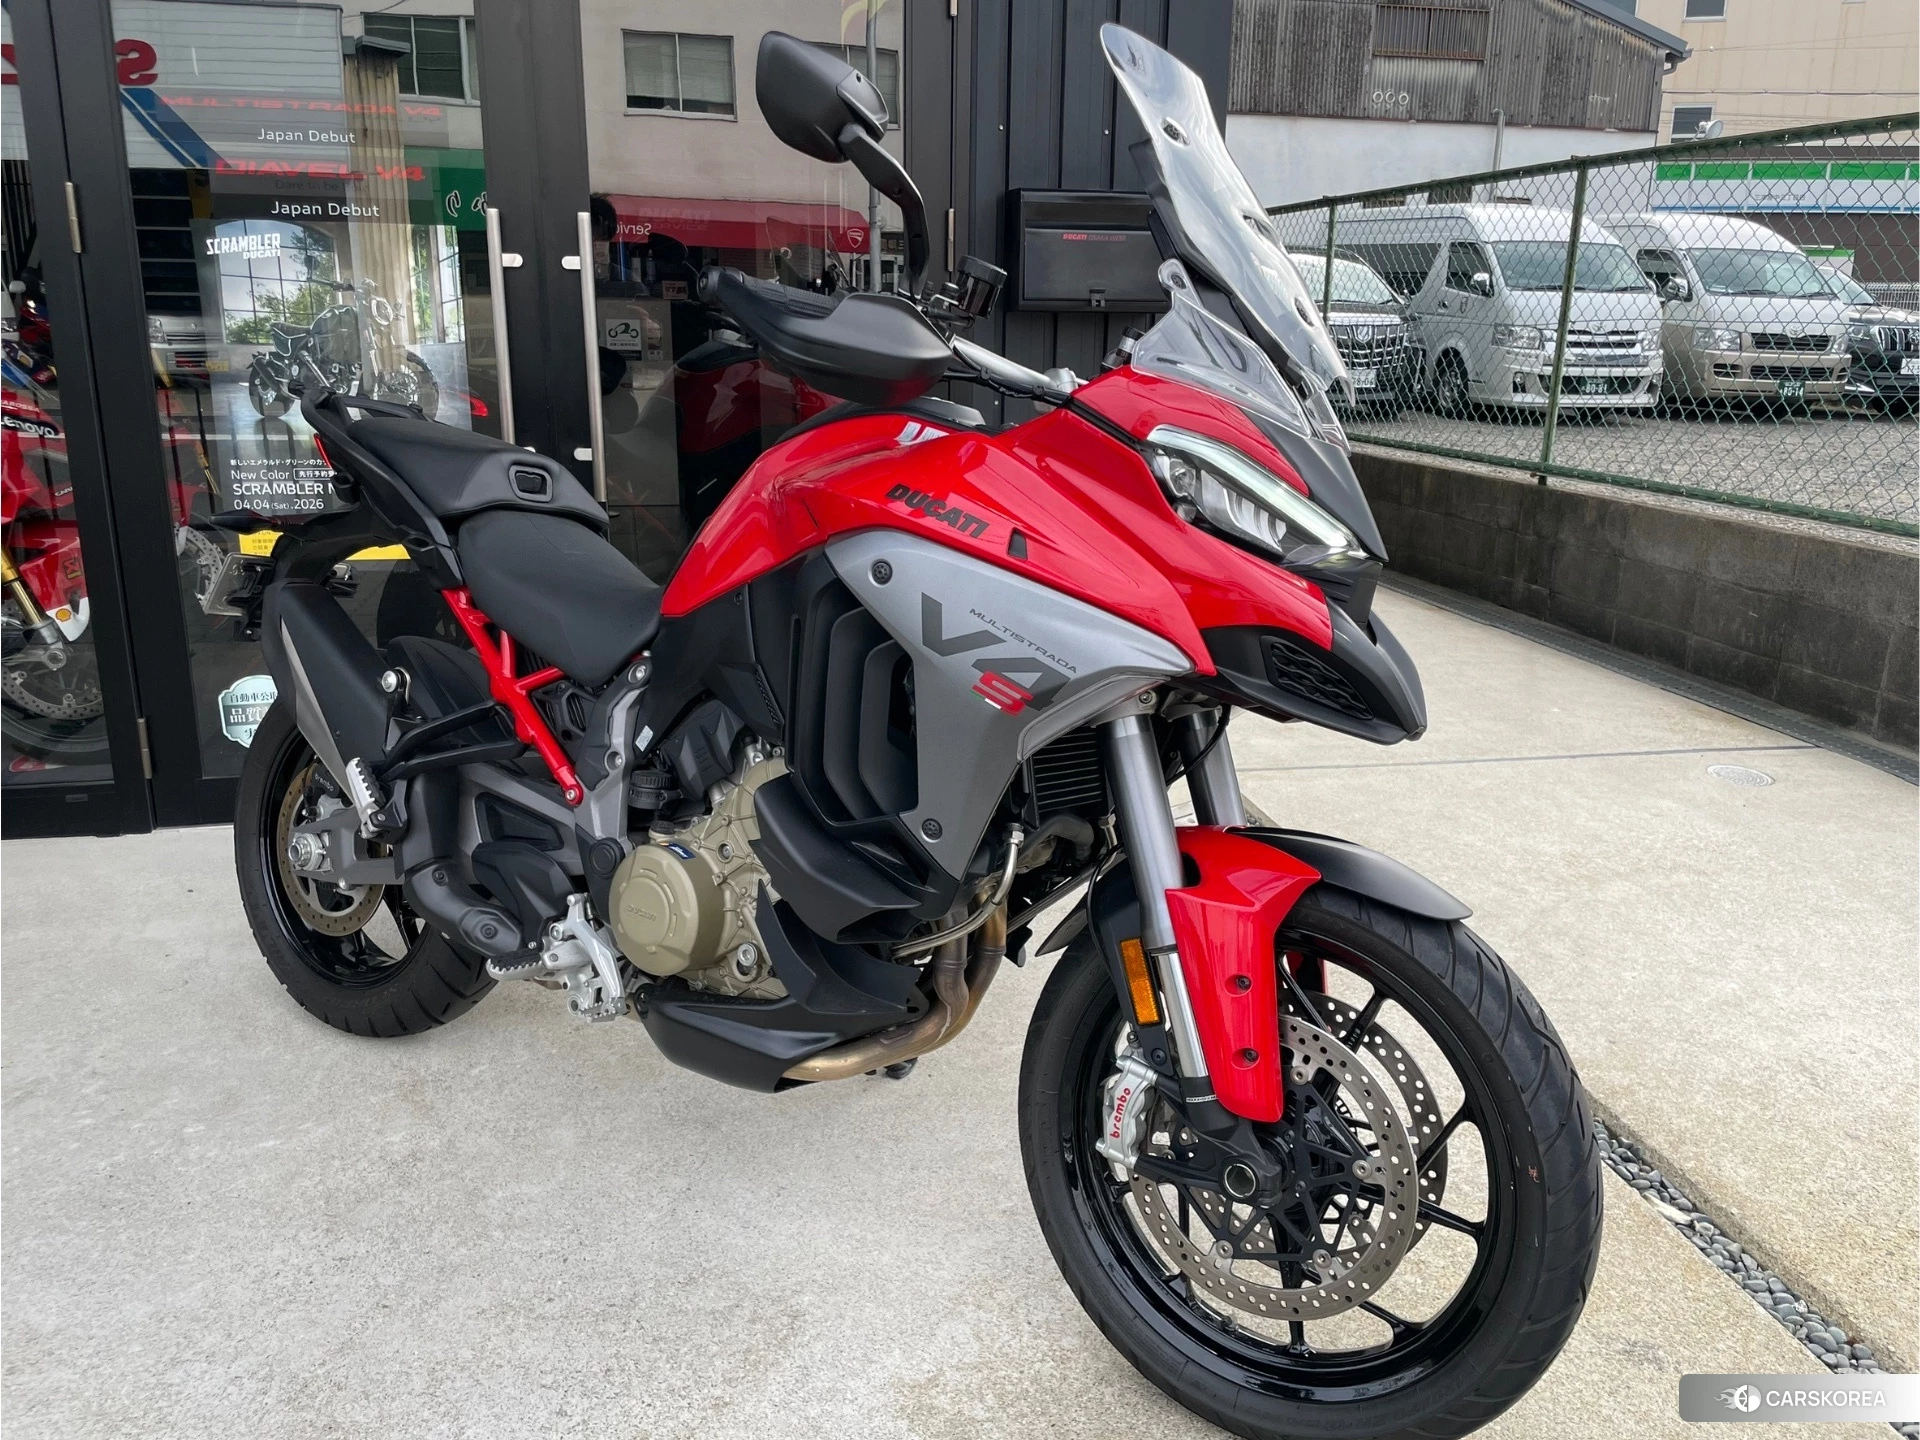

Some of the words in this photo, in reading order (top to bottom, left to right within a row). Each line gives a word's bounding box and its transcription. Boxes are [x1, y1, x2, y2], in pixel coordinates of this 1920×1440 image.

[160, 94, 397, 115] MULTISTRADA
[404, 105, 442, 117] V4
[257, 128, 303, 143] Japan
[309, 130, 356, 144] Debut
[215, 158, 367, 181] DIAVEL
[375, 164, 426, 182] V4
[271, 201, 322, 217] Japan
[328, 203, 380, 218] Debut
[206, 233, 281, 255] SCRAMBLER
[243, 249, 281, 260] DUCATI
[231, 469, 257, 481] New
[260, 469, 290, 481] Color
[232, 482, 324, 496] SCRAMBLER
[885, 483, 990, 539] DUCATI
[921, 592, 1072, 712] V4
[969, 608, 1078, 674] MULTISTRADA
[1109, 1087, 1131, 1139] brembo
